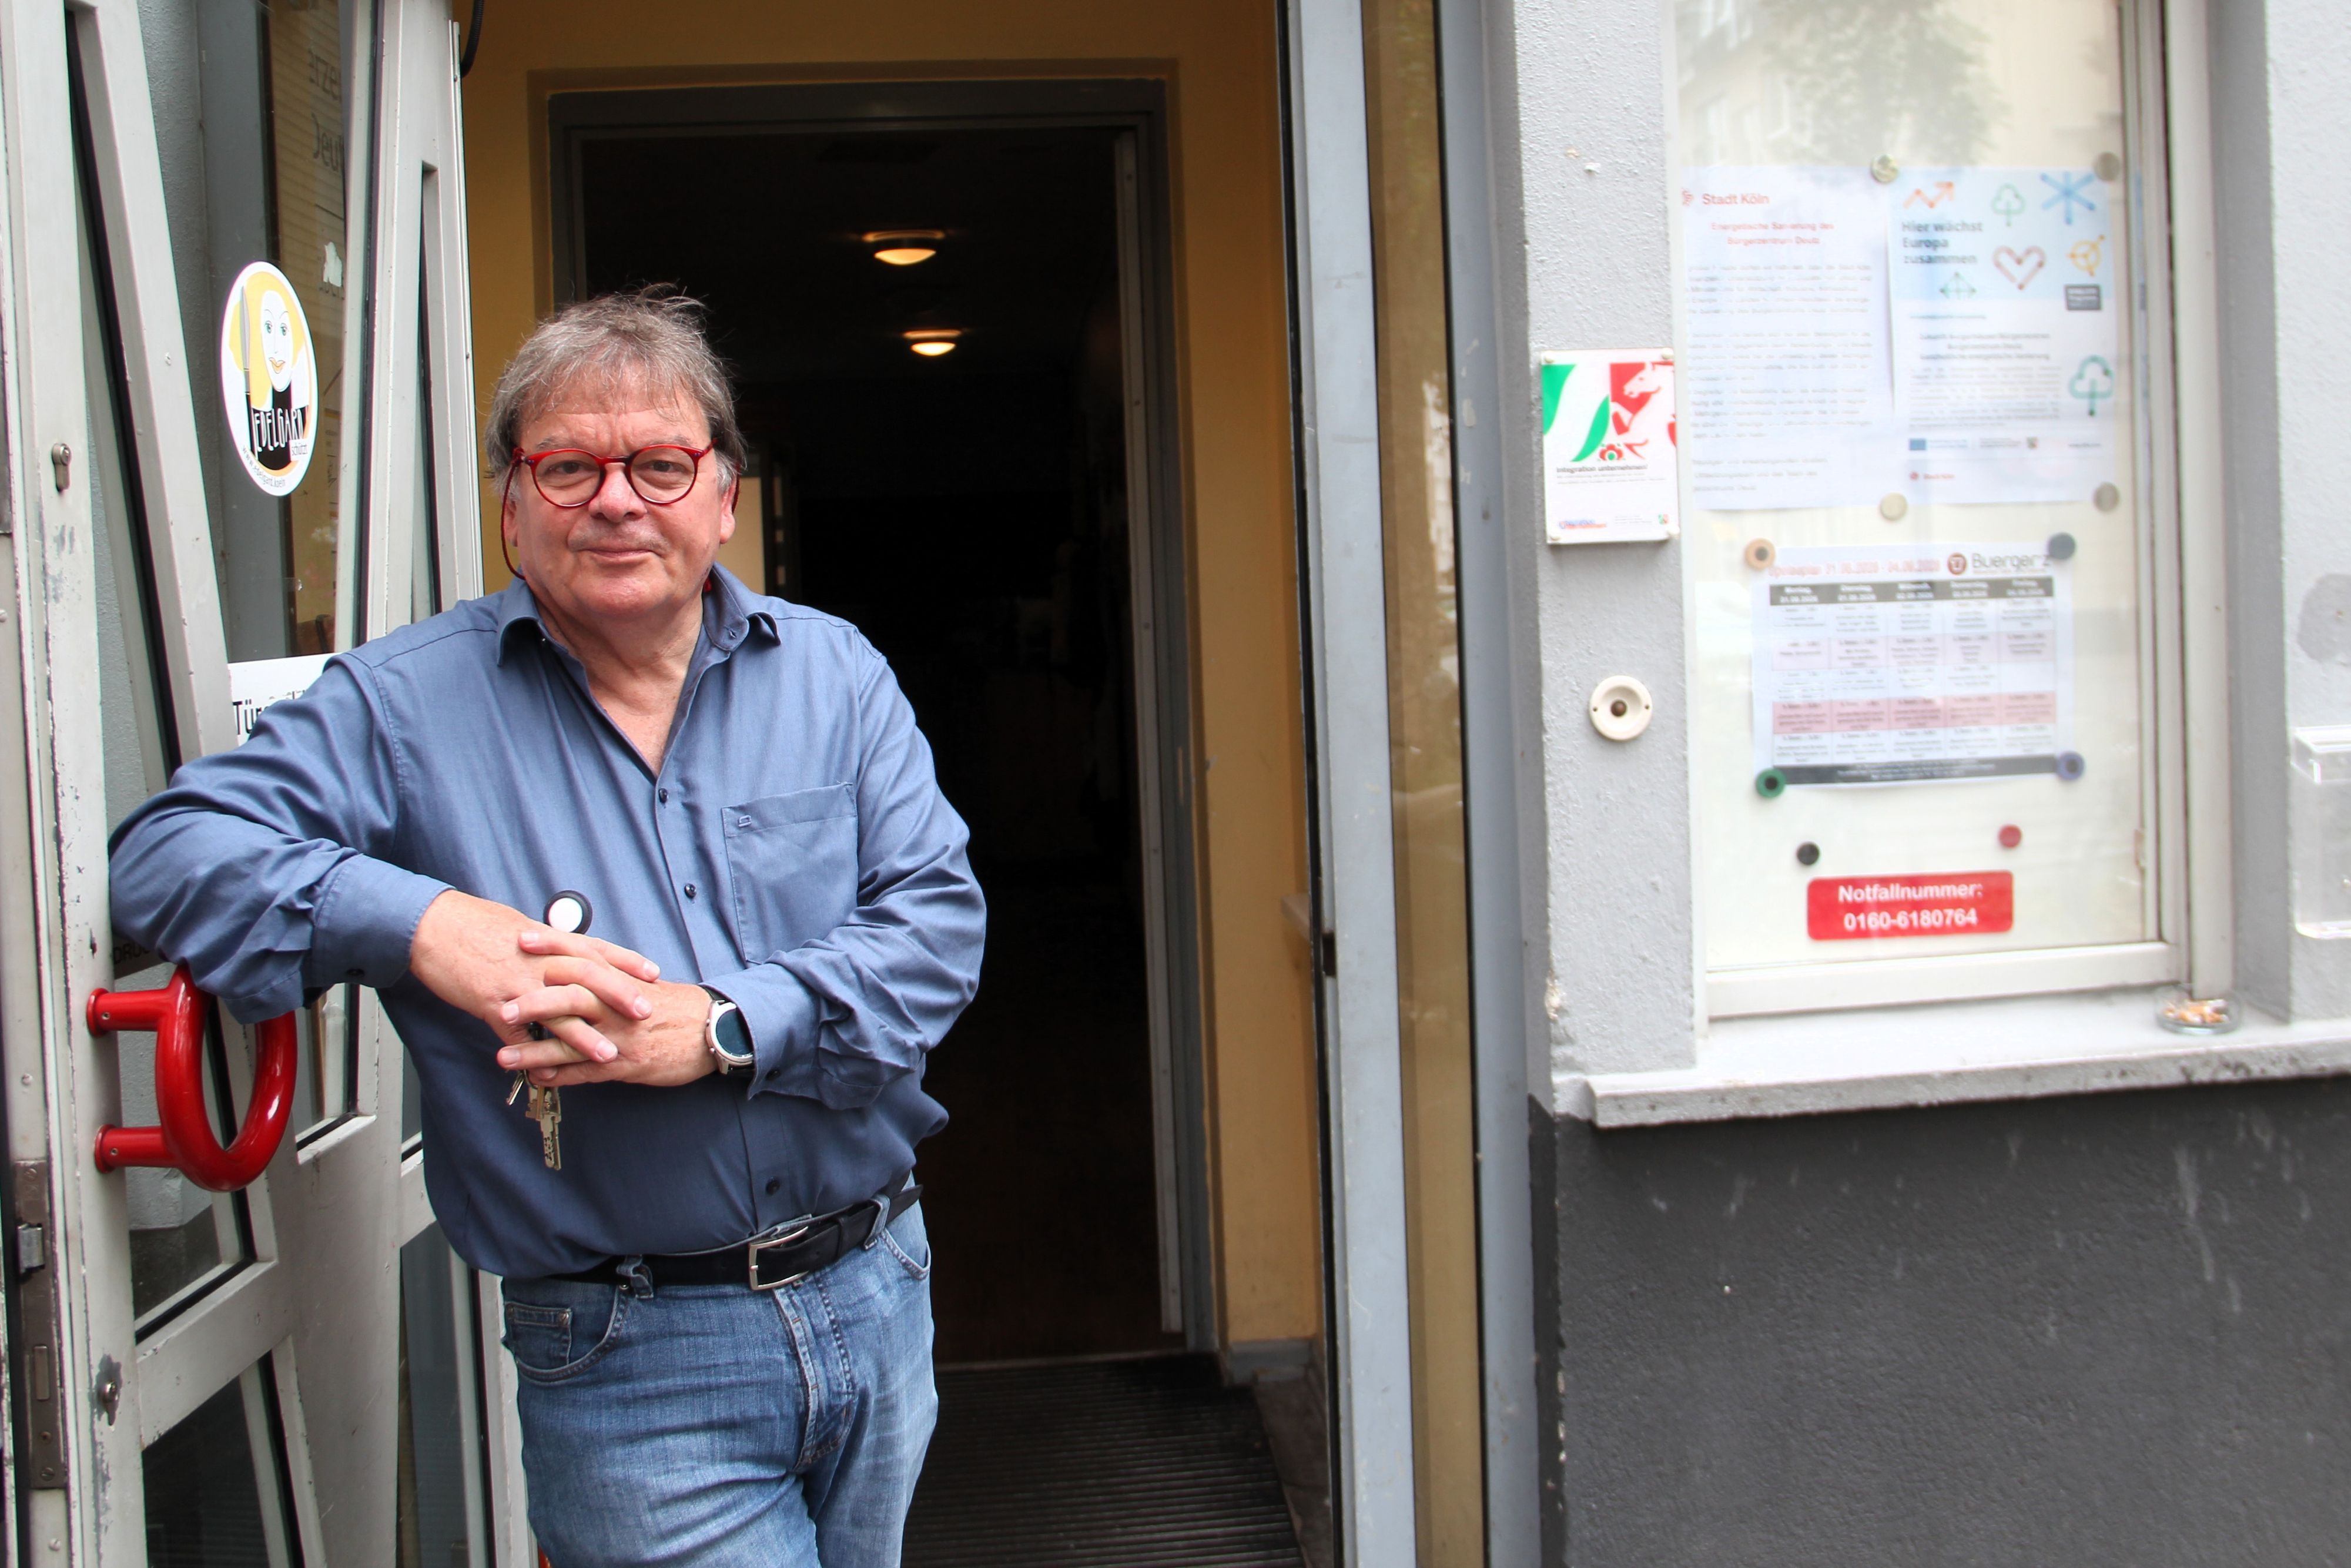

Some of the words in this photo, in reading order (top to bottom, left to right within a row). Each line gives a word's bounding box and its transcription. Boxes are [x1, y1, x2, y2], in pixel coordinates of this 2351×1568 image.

[1702, 193, 1738, 205] Stadt
[1741, 192, 1770, 205] Köln
[1901, 221, 1929, 232] Hier
[1932, 220, 1983, 232] wächst
[1902, 237, 1950, 251] Europa
[1903, 255, 1978, 264] zusammen
[1838, 883, 1983, 903] Notfallnummer:
[1844, 907, 1978, 931] 0160-6180764
